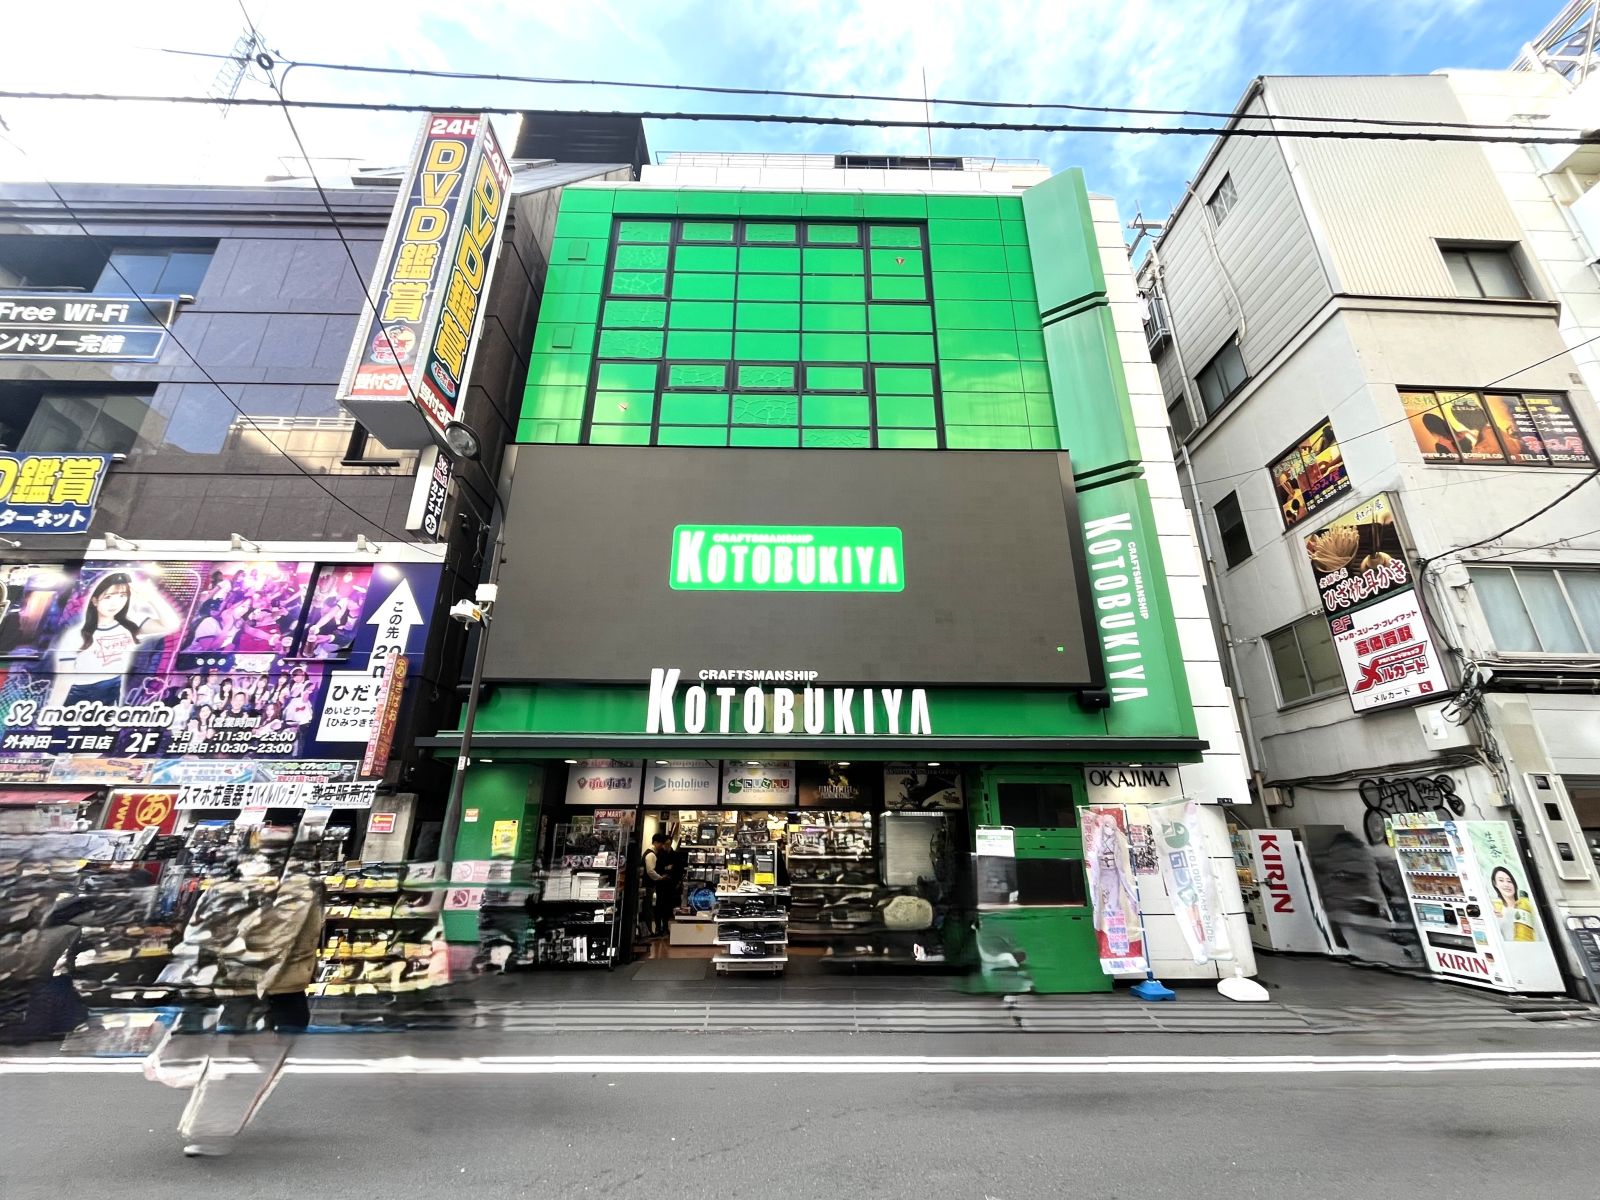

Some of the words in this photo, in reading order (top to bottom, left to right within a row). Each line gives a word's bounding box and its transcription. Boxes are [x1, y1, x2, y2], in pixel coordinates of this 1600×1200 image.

[430, 119, 478, 136] 24H
[485, 131, 508, 191] 24H
[381, 140, 467, 324] DVD鑑賞
[433, 153, 502, 384] DVD鑑賞
[0, 302, 56, 321] Free
[64, 303, 129, 322] Wi-Fi
[712, 533, 814, 544] CRAFTSMANSHIP
[677, 531, 898, 584] KOTOBUKIYA
[1127, 541, 1149, 620] CRAFTSMANSHIP
[1323, 559, 1407, 611] ひざ枕耳かき
[385, 601, 404, 639] この先
[1084, 513, 1148, 702] KOTOBUKIYA
[1331, 615, 1352, 635] 2F
[699, 669, 818, 681] CRAFTSMANSHIP
[1353, 657, 1427, 693] メルカード
[646, 668, 932, 735] KOTOBUKIYA
[1373, 687, 1411, 703] メルカード
[40, 702, 172, 725] maidreamin
[3, 734, 113, 750] 外神田一丁目店
[125, 733, 159, 752] 2F
[667, 777, 710, 789] hololive
[1089, 769, 1170, 788] OKAJIMA
[178, 784, 244, 807] スマホ充電器
[1258, 834, 1295, 914] KIRIN
[1435, 951, 1489, 976] KIRIN
